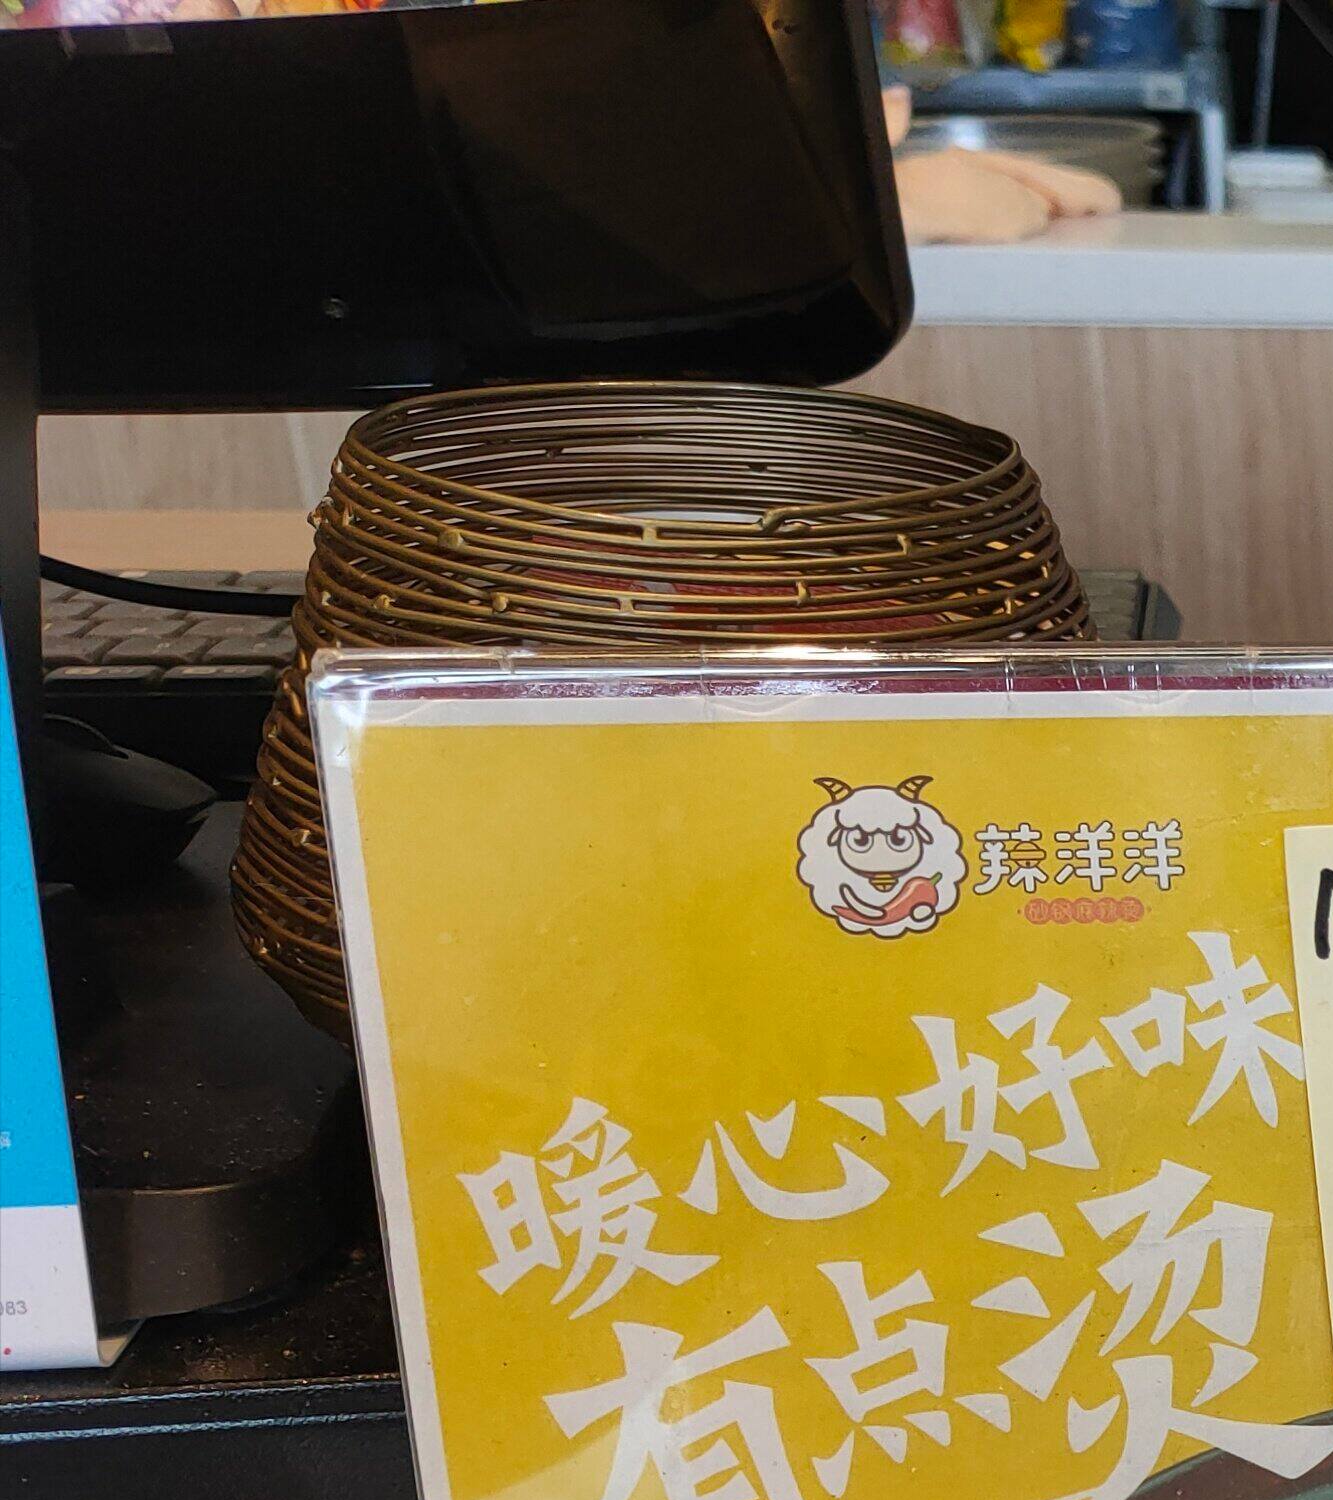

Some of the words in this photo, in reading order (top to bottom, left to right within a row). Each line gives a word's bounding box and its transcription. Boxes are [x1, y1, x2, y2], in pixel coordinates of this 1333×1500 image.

[973, 818, 1185, 895] 辣洋洋
[456, 931, 1306, 1320] 暖心好味
